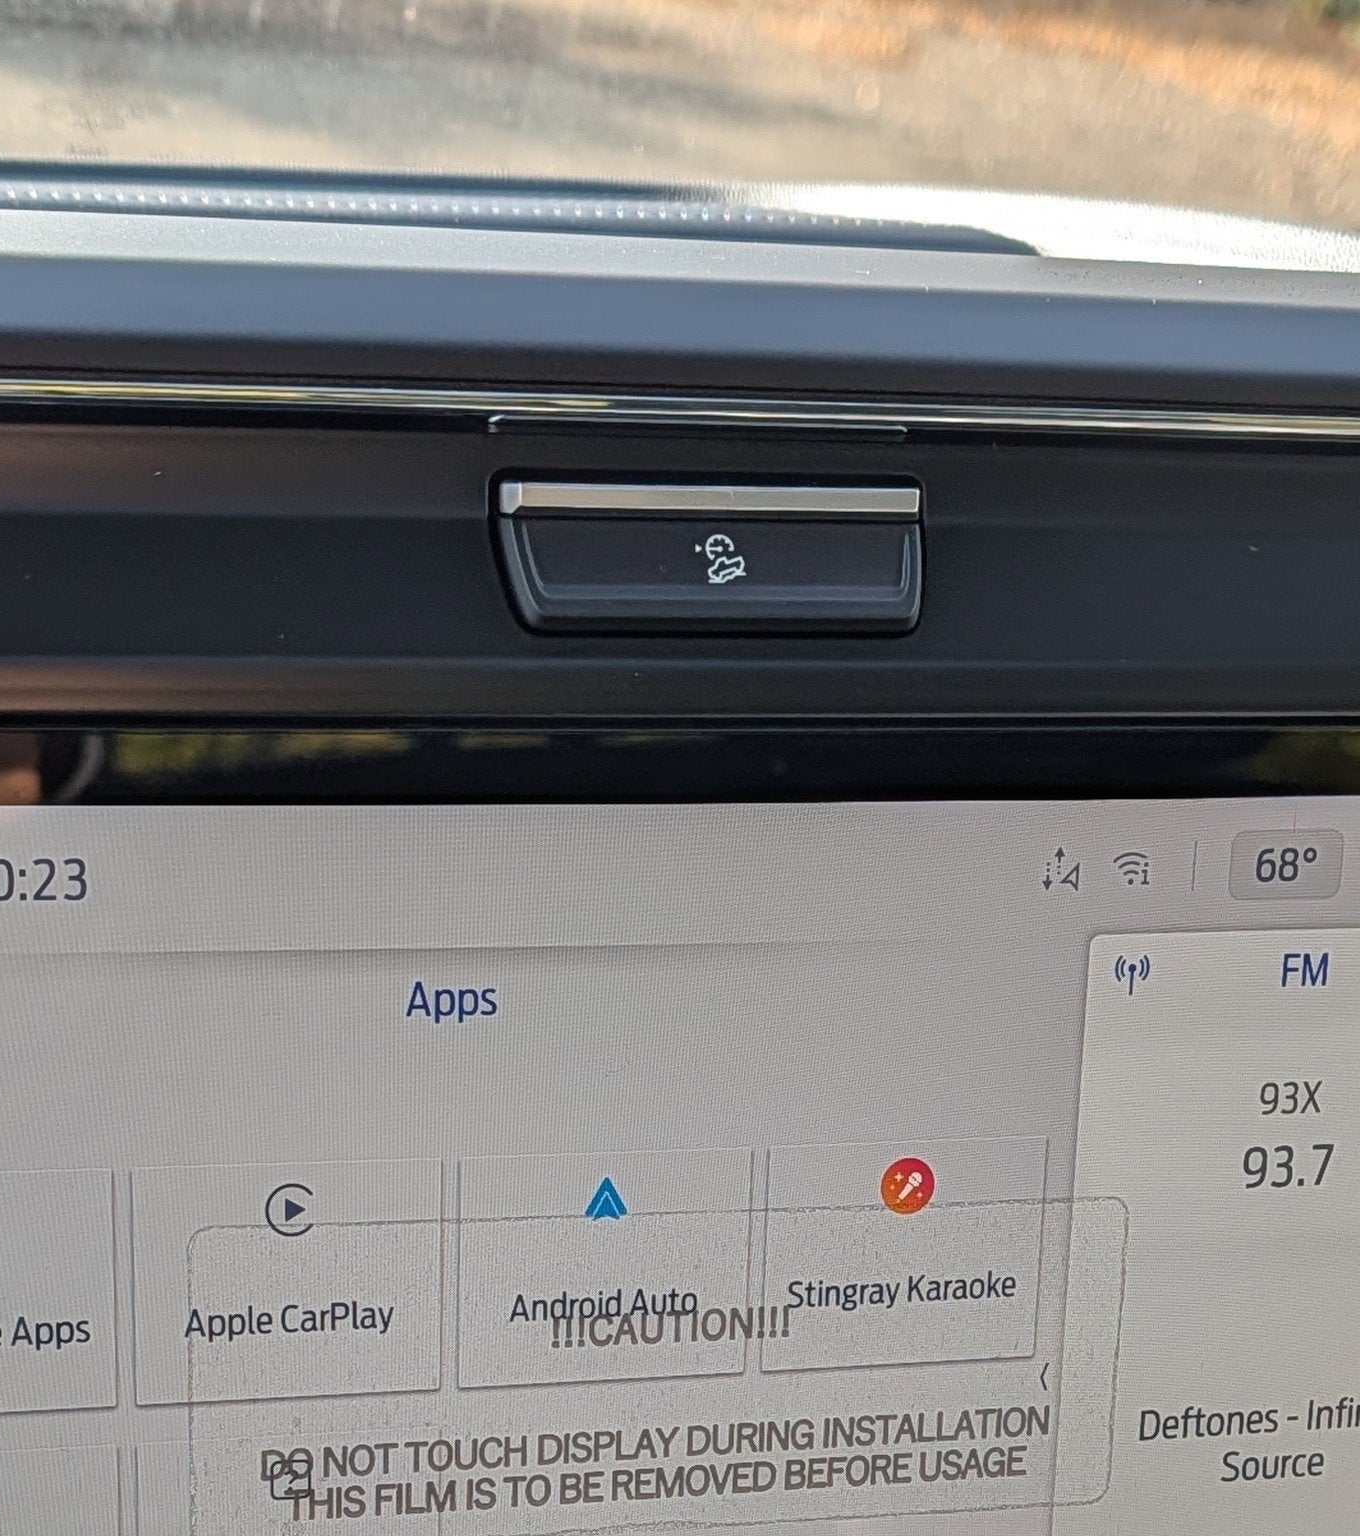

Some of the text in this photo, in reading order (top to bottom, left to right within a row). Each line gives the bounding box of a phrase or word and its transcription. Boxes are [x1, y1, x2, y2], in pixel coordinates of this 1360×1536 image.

[1254, 846, 1318, 883] 68°
[1280, 951, 1330, 988] FM
[405, 980, 499, 1024] Apps
[1258, 1079, 1323, 1116] 93X
[1241, 1143, 1335, 1189] 93.7
[509, 1288, 699, 1323] Android Auto
[787, 1269, 1018, 1312] Stingray Karaoke
[10, 1317, 92, 1349] Apps
[183, 1300, 395, 1341] Apple CarPlay
[1139, 1406, 1280, 1441] Deftones
[260, 1403, 1052, 1484] DO NOT TOUCH DISPLAY DURING INSTALLATION
[289, 1443, 1029, 1522] THIS FILM IS TO BE REMOVED BEFORE USAGE
[1220, 1449, 1326, 1484] Source
